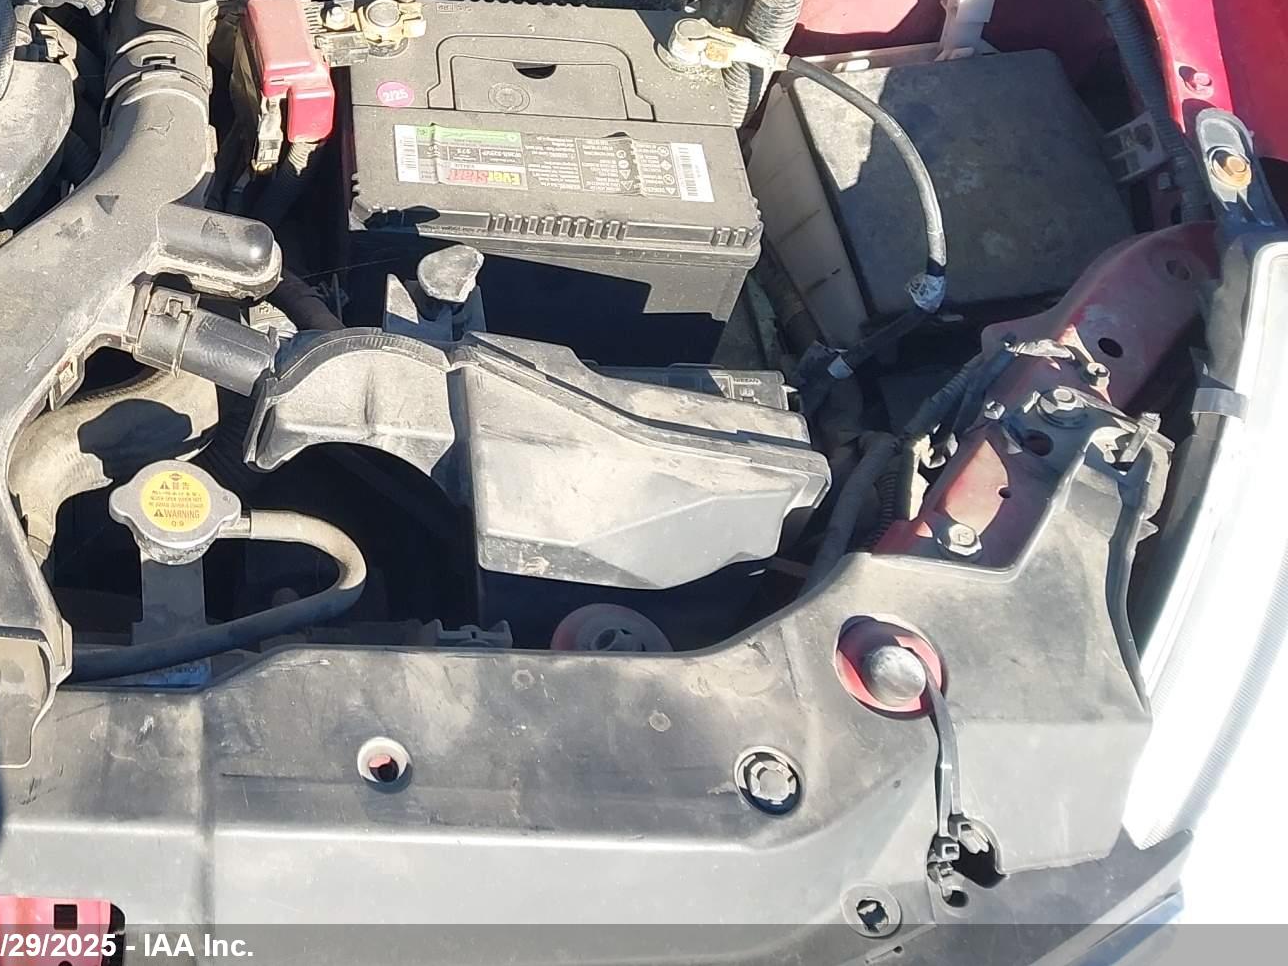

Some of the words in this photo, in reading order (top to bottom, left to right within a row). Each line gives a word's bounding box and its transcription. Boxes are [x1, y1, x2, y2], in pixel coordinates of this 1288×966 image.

[382, 88, 409, 102] 2/25
[450, 169, 521, 186] EverStart
[164, 509, 200, 519] WARNING
